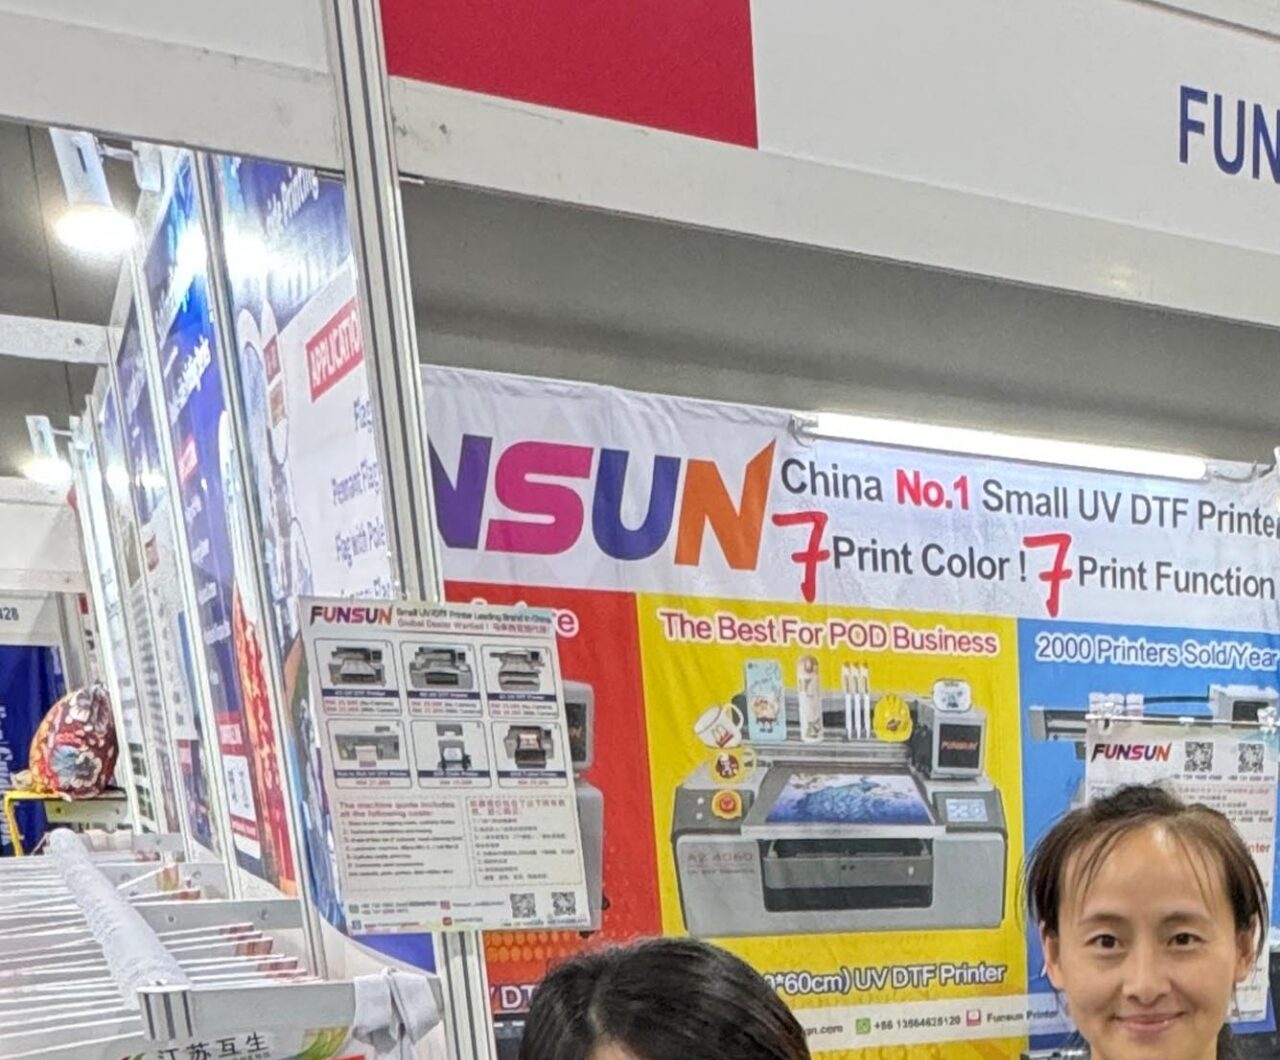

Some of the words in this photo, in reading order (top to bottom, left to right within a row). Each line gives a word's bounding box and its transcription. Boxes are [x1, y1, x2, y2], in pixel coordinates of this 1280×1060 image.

[310, 306, 362, 390] APPLICATIO
[427, 432, 777, 571] NSUN
[781, 457, 883, 503] China
[896, 468, 971, 511] No.1
[982, 479, 1068, 521] Small
[1078, 490, 1122, 524] UV
[1130, 494, 1189, 531] DTF
[772, 511, 830, 604] 7
[831, 535, 913, 577] Print
[921, 542, 1010, 582] Color
[1023, 532, 1074, 619] 7
[1078, 556, 1148, 592] Print
[310, 605, 393, 627] FUNSUN
[660, 612, 713, 640] The
[718, 617, 777, 644] Best
[780, 618, 824, 645] For
[830, 624, 888, 649] POD
[892, 627, 997, 653] Business
[1037, 637, 1091, 661] 2000
[1096, 638, 1179, 666] Printers
[1183, 641, 1279, 670] Sold/Year
[1091, 742, 1172, 762] FUNSUN
[854, 967, 889, 991] UV
[892, 965, 937, 989] DTF
[939, 962, 1006, 986] Printer
